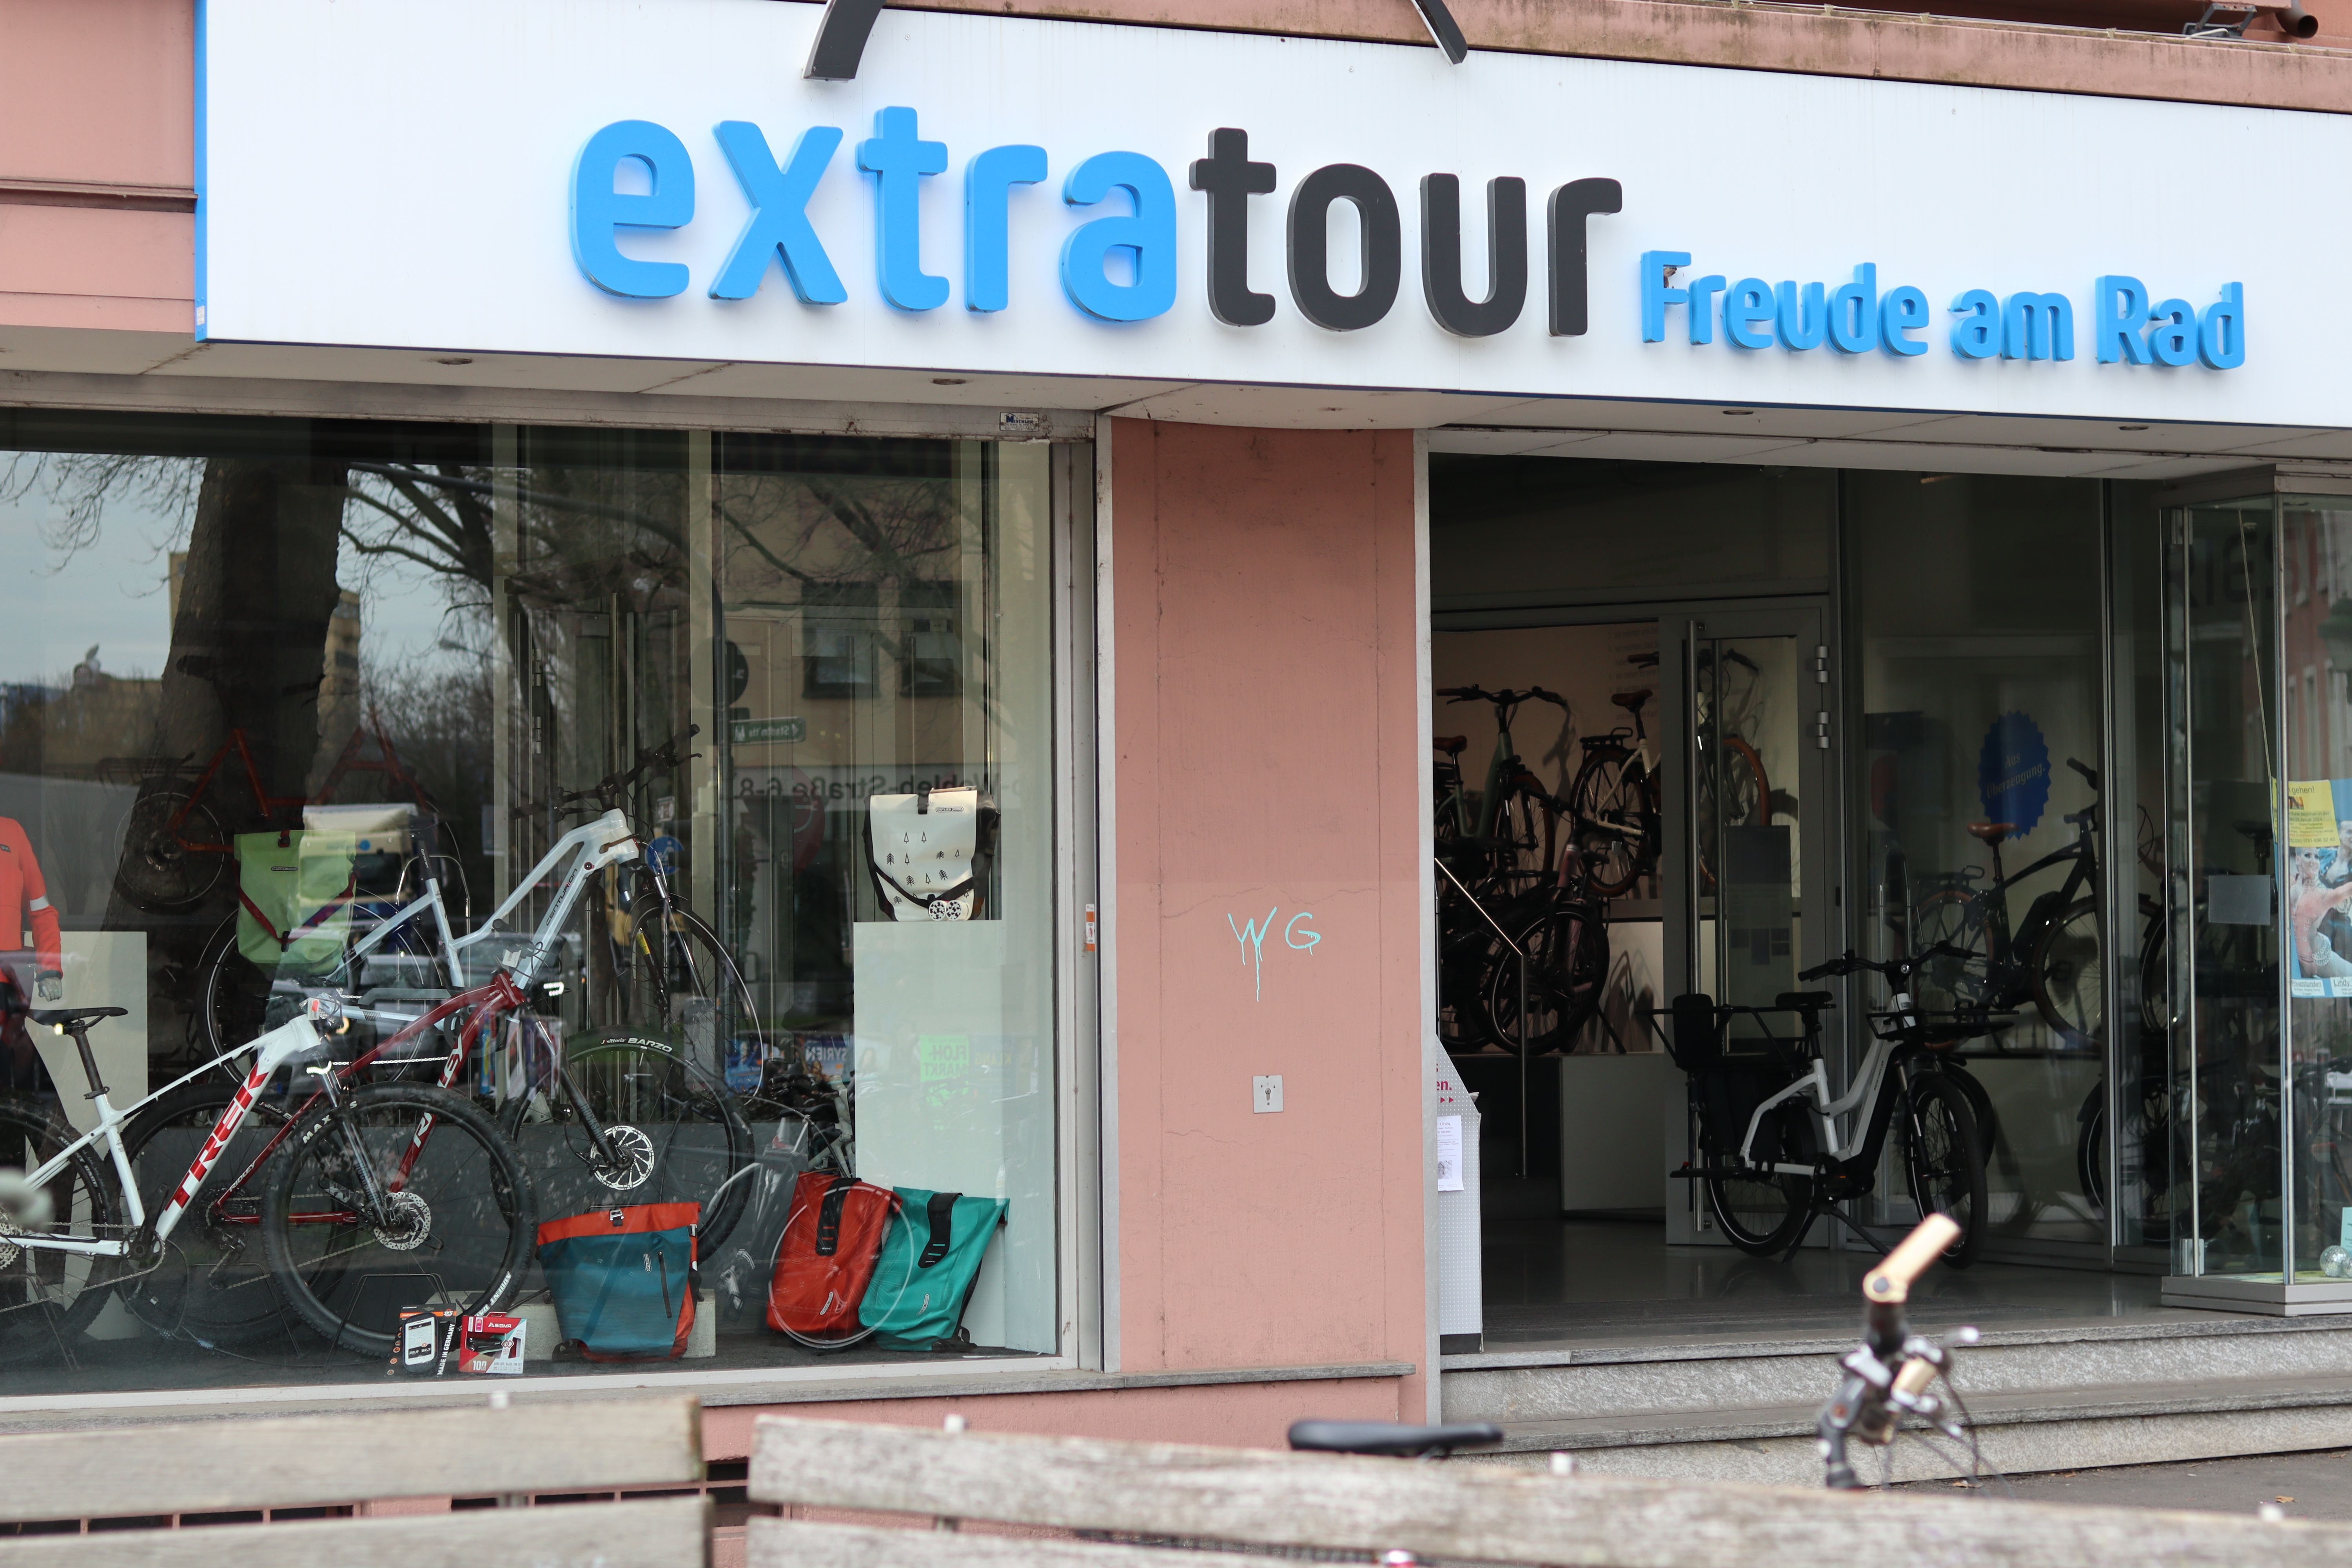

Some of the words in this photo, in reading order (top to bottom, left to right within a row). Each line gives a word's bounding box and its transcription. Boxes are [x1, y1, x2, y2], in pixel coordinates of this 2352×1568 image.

[570, 107, 1622, 341] extratour
[1641, 250, 1929, 357] Freude
[1949, 289, 2074, 362] am
[2095, 275, 2245, 371] Rad
[2292, 786, 2315, 795] gehen!
[627, 1037, 673, 1053] BARZO
[437, 1358, 446, 1375] MADE
[443, 1323, 456, 1351] GERMANY
